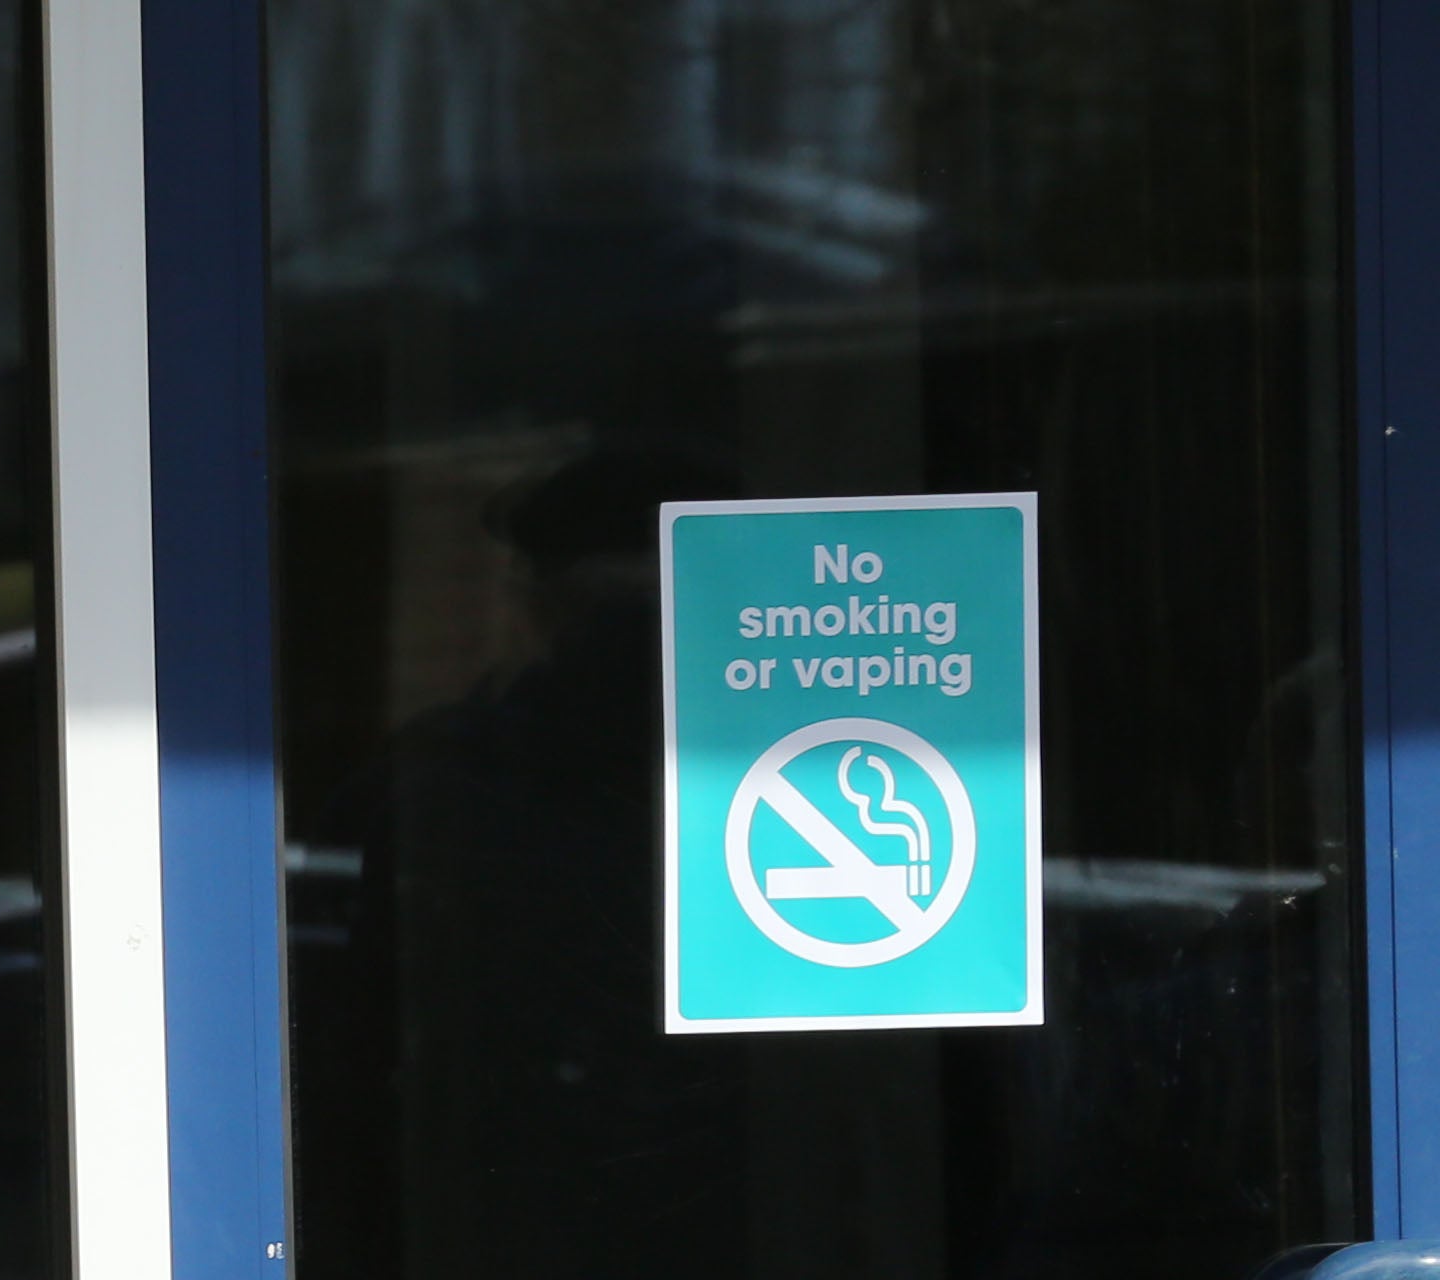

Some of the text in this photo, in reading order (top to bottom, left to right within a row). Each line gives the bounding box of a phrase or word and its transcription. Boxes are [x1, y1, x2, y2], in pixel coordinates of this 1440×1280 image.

[813, 543, 884, 585] No
[738, 595, 958, 646] smoking
[724, 646, 973, 697] or vaping
